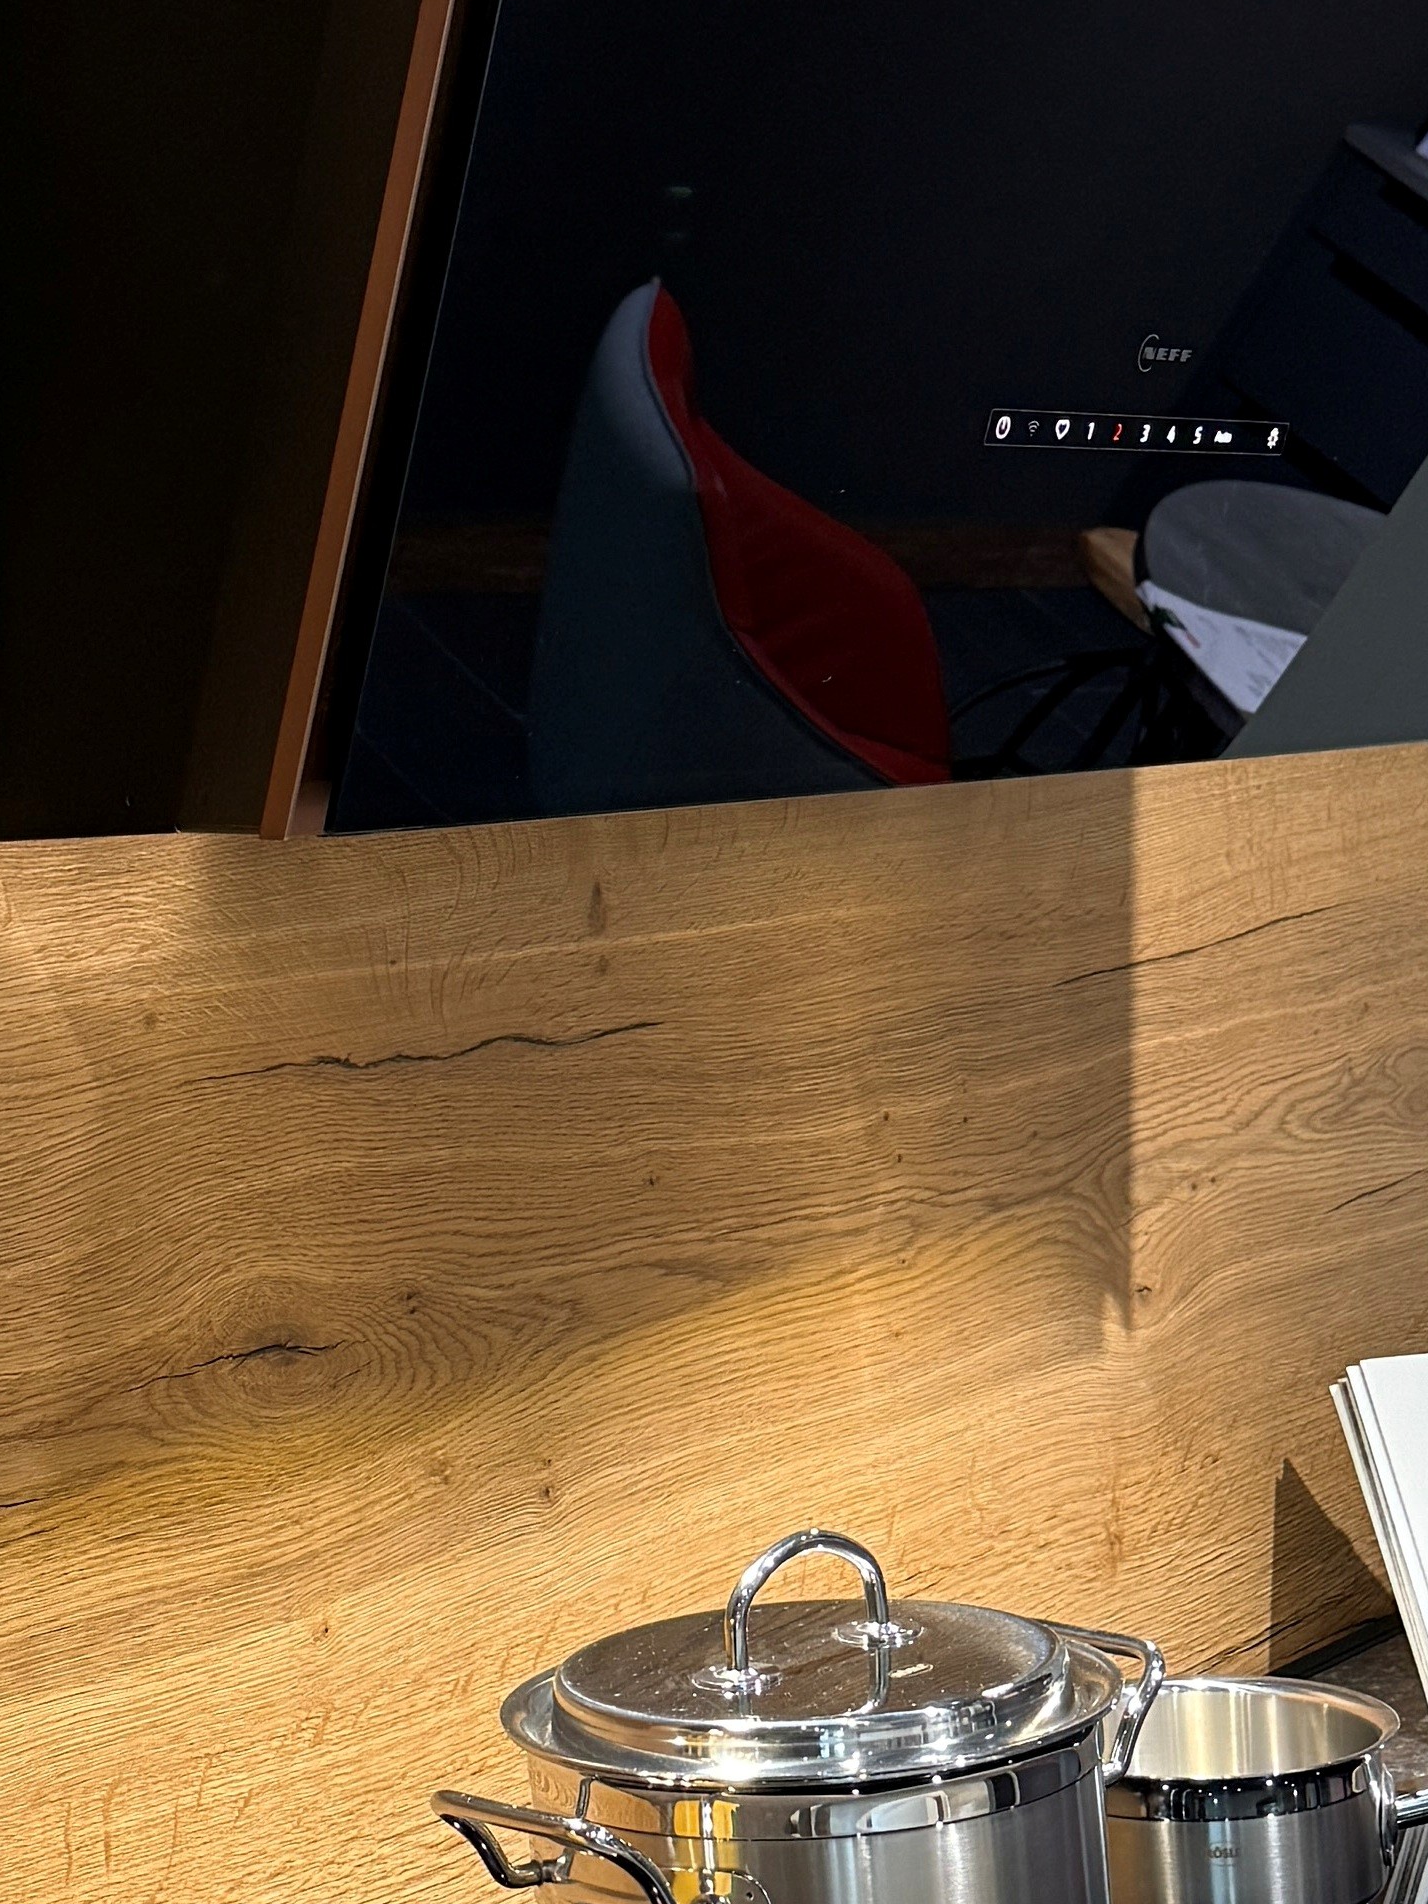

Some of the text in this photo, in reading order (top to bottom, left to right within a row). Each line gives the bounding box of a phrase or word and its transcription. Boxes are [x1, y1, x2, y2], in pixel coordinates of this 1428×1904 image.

[1143, 346, 1192, 362] NEFF
[1087, 422, 1095, 441] 1
[1113, 423, 1122, 441] 2
[1139, 424, 1151, 443] 3
[1166, 425, 1176, 444] 4
[1192, 426, 1203, 444] 5
